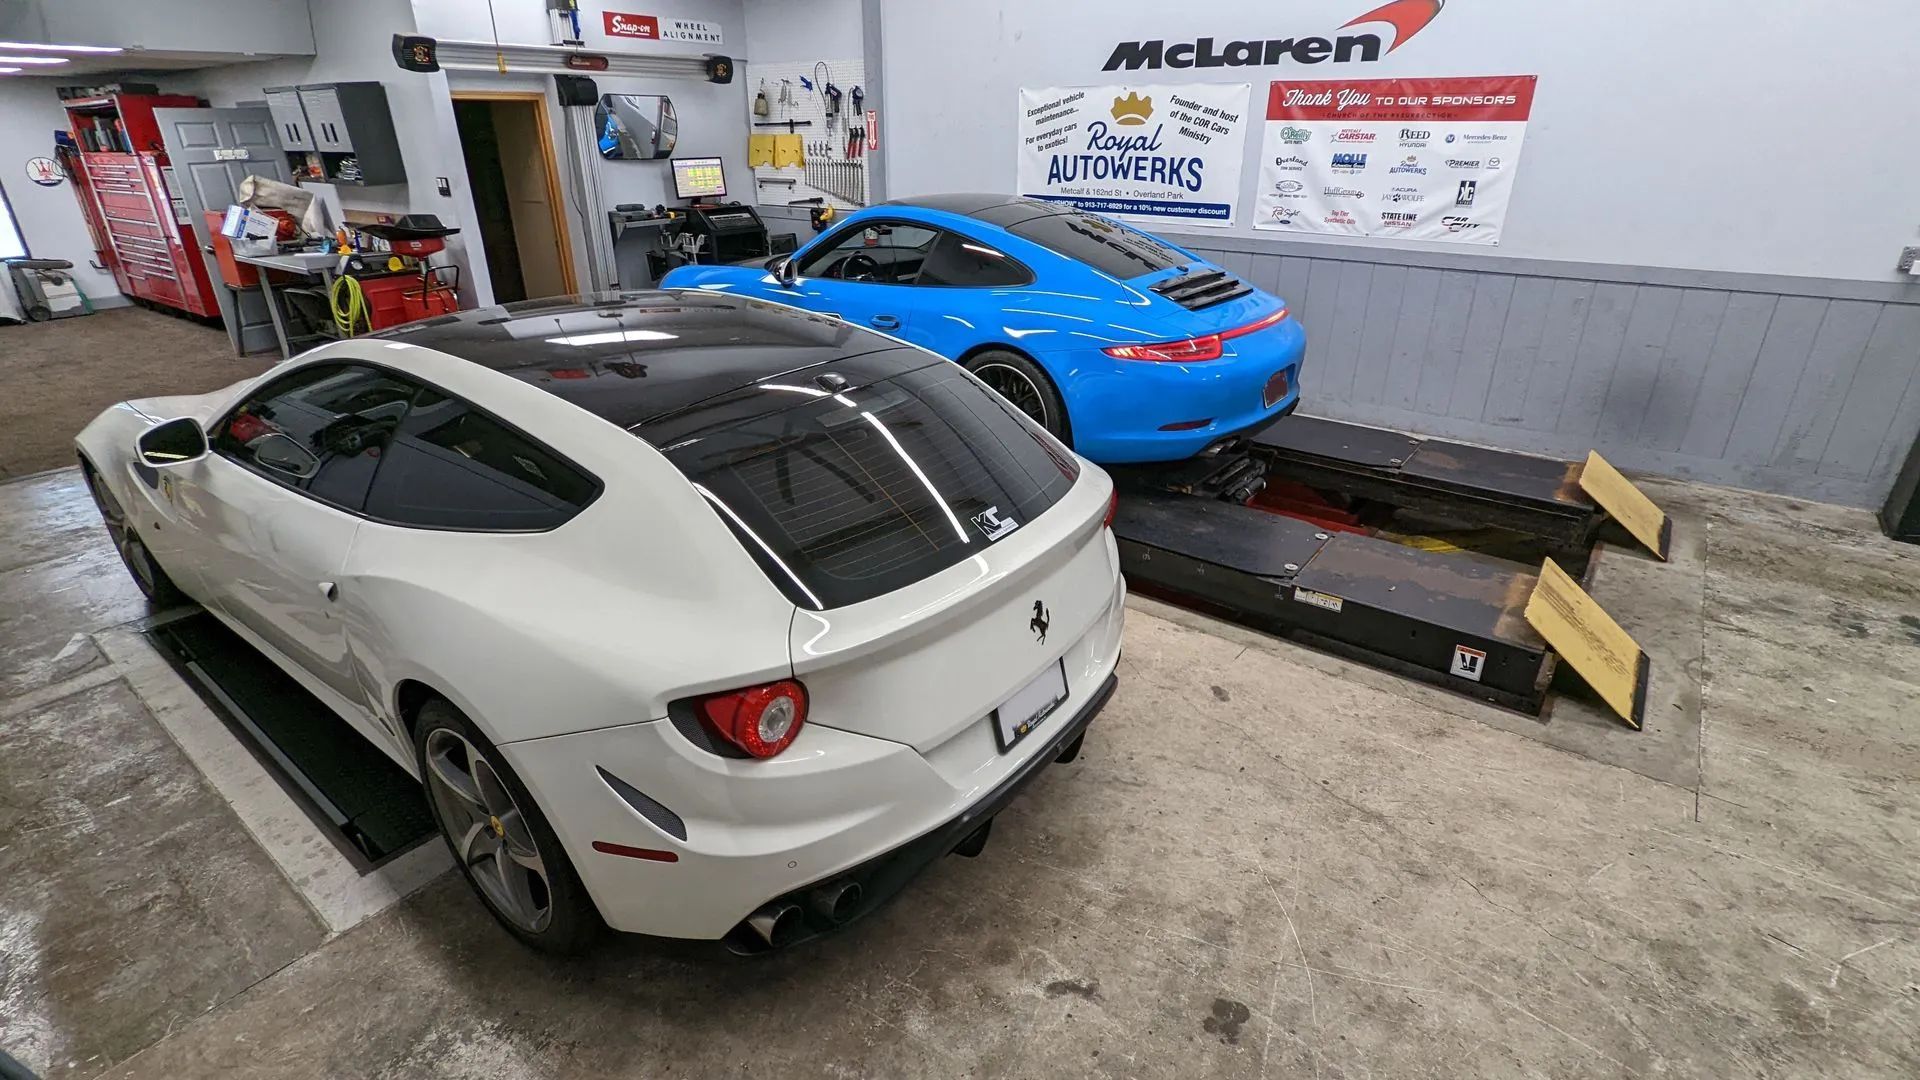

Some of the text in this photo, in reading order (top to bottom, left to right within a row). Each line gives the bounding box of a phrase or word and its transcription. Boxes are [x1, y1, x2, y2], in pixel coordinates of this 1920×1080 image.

[612, 15, 651, 35] Snap-on
[675, 21, 708, 32] WHEEL
[663, 30, 721, 42] ALIGNMENT
[1101, 33, 1382, 72] McLaren
[1027, 91, 1085, 118] Exceptional vehicle
[1283, 88, 1517, 111] Thank You TO OUR SPONSORS
[1169, 94, 1239, 123] Founder and host
[1169, 110, 1230, 135] of the COR Cars
[1025, 122, 1078, 145] For everyday cars
[1178, 126, 1212, 145] Ministry
[1399, 128, 1431, 141] REED
[1037, 135, 1069, 152] to exotics!
[1086, 120, 1163, 163] Royal
[1275, 155, 1309, 167] Overland
[1332, 153, 1368, 163] MOLLE
[1448, 159, 1480, 167] PREMIER
[1047, 154, 1204, 192] AUTOWERKS
[1388, 166, 1428, 176] AUTOWERKS
[1060, 187, 1085, 195] Metcalf
[1092, 188, 1113, 196] 162nd
[1114, 189, 1122, 197] St
[1133, 189, 1165, 199] Overland
[1166, 191, 1184, 200] Park
[1382, 193, 1425, 202] JAY WOLFE
[1138, 204, 1152, 212] 10%
[1197, 207, 1227, 215] discount
[1331, 209, 1339, 217] Top
[1323, 216, 1346, 225] Synthetic
[1381, 211, 1418, 222] STATE LINE
[971, 505, 1015, 536] KC
